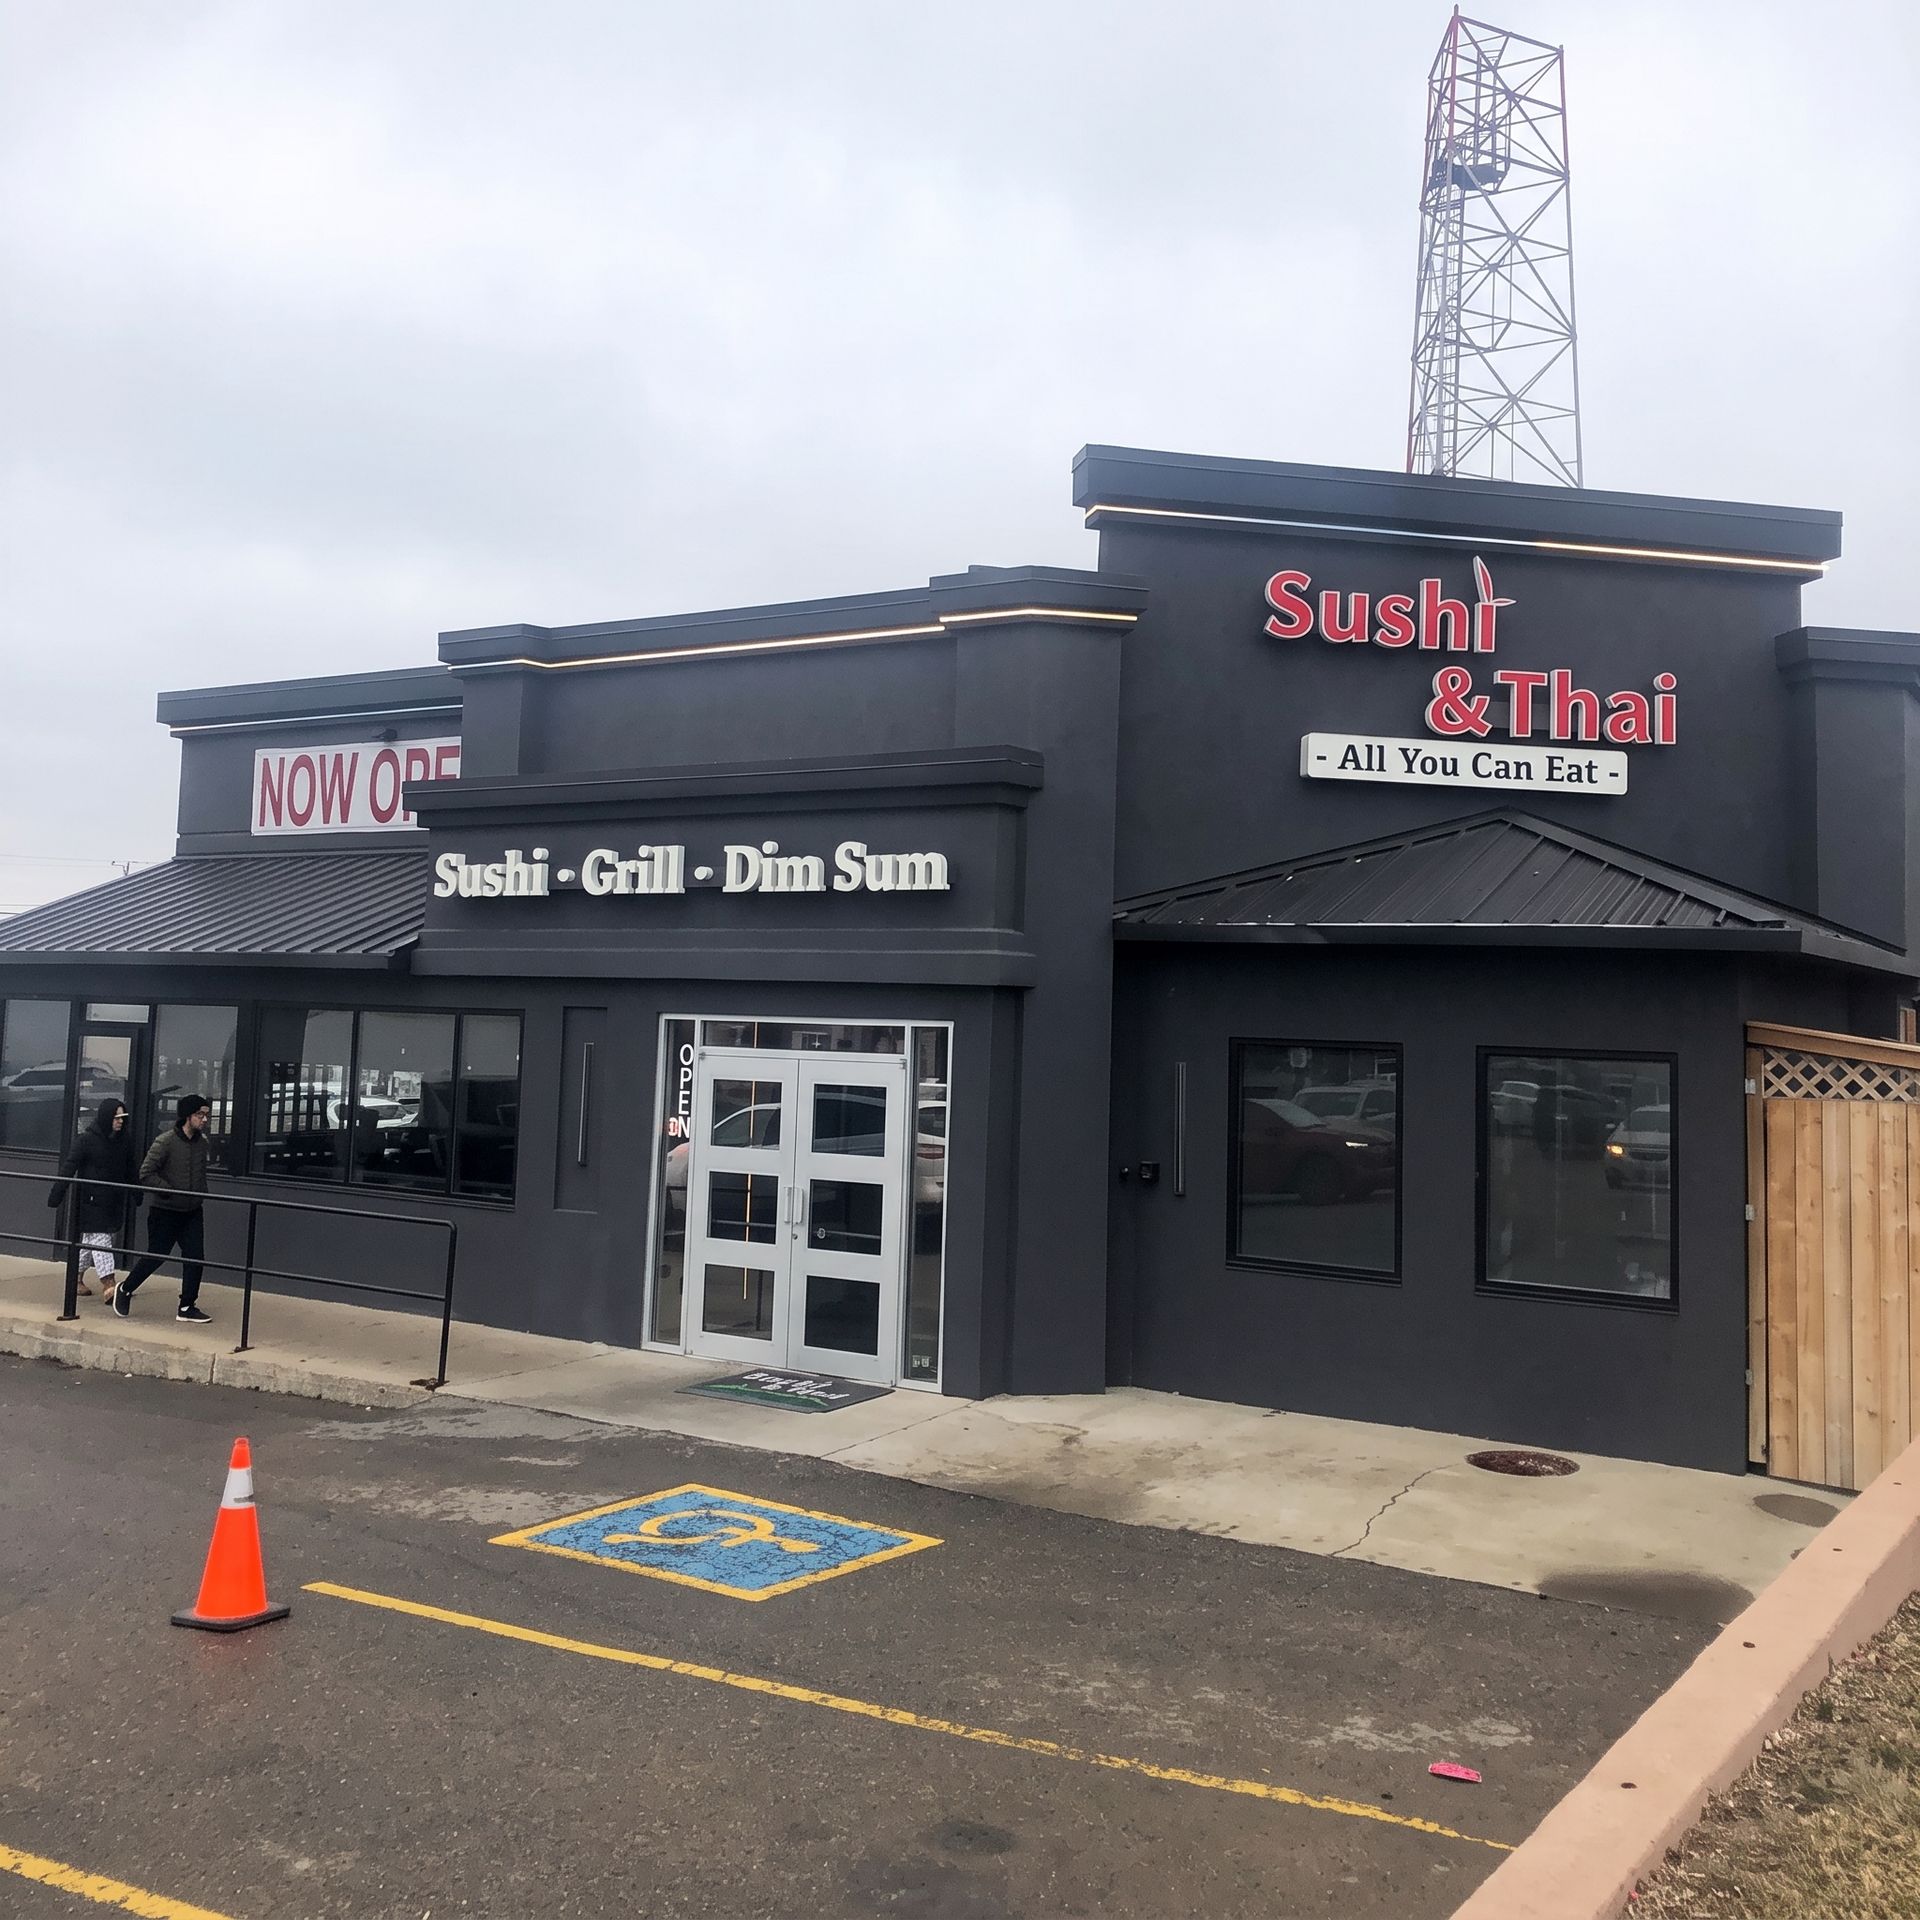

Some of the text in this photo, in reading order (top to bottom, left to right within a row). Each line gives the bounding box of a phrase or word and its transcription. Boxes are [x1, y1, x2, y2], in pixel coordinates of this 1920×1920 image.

[1264, 555, 1517, 653] Sushi
[259, 752, 359, 827] NOW
[1337, 744, 1386, 772] All
[1398, 748, 1459, 777] You
[1471, 752, 1533, 781] Can
[1545, 756, 1598, 784] Eat
[434, 847, 550, 898] Sushi
[581, 844, 686, 896] Grill
[722, 841, 827, 893] Dim
[832, 841, 950, 893] Sum
[678, 1043, 694, 1139] OPEN
